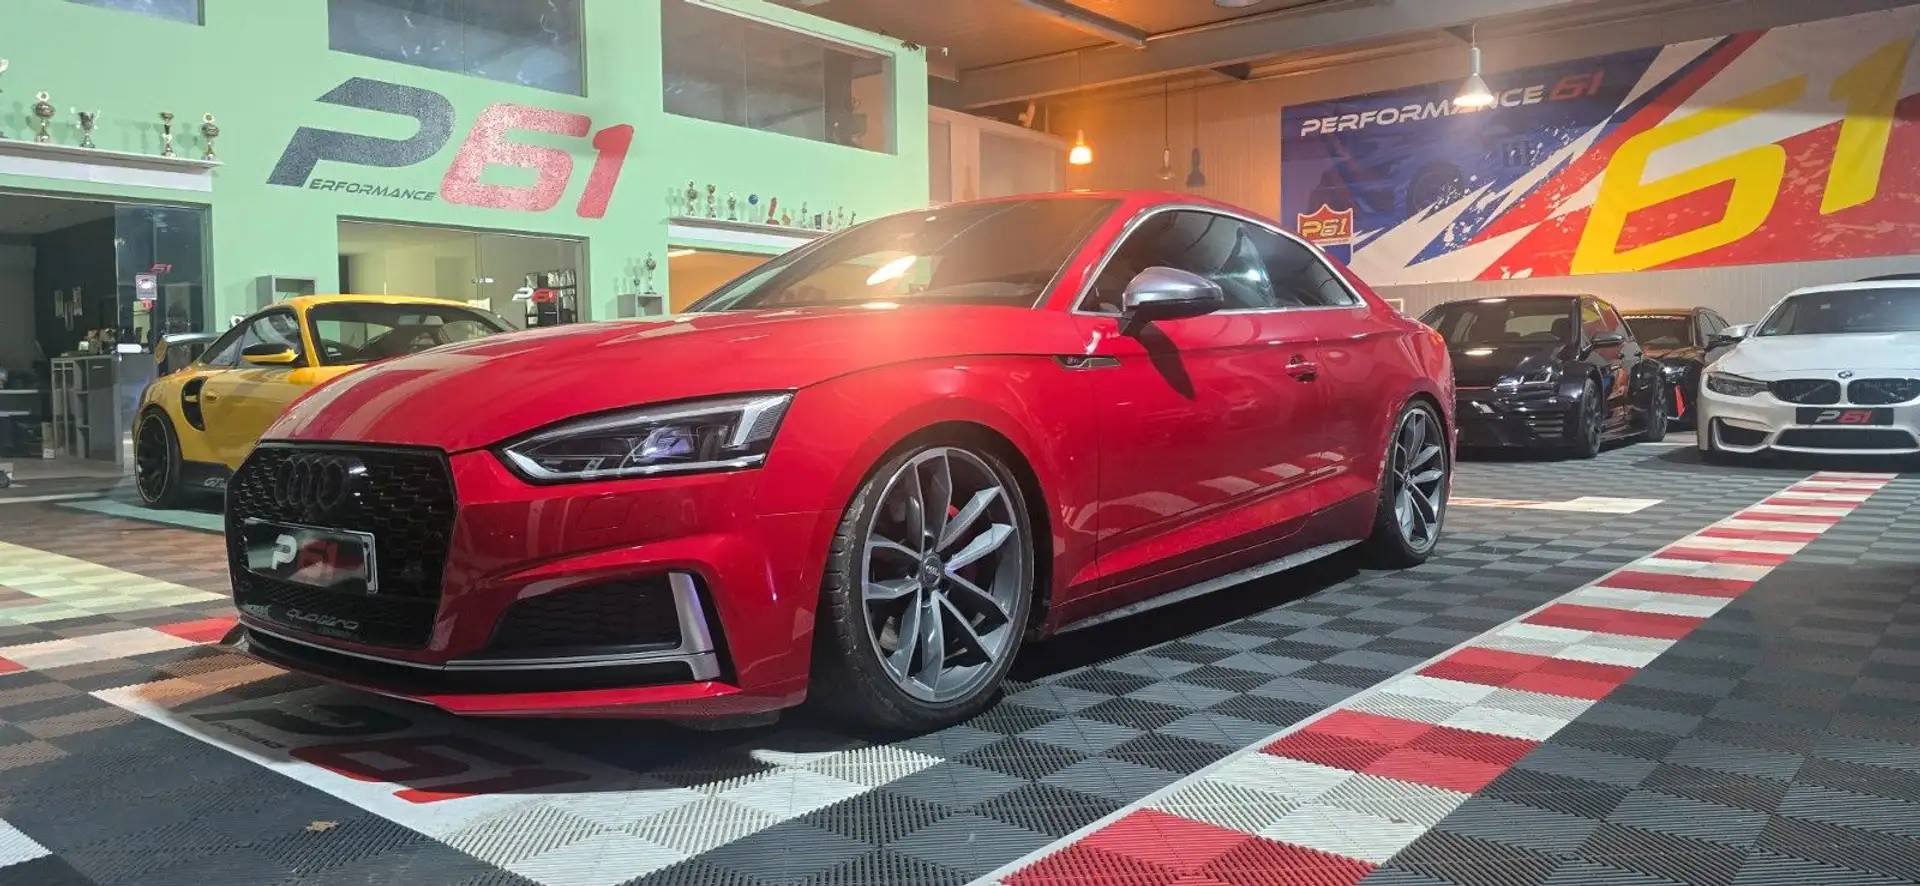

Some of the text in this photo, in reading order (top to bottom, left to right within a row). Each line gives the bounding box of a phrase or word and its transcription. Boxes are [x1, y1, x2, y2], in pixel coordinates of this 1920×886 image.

[1552, 70, 1605, 101] 61
[1570, 36, 1911, 275] 61
[309, 178, 437, 201] ERFORMANCE
[1302, 218, 1348, 238] P61
[511, 287, 558, 304] P61
[1815, 410, 1873, 423] P61
